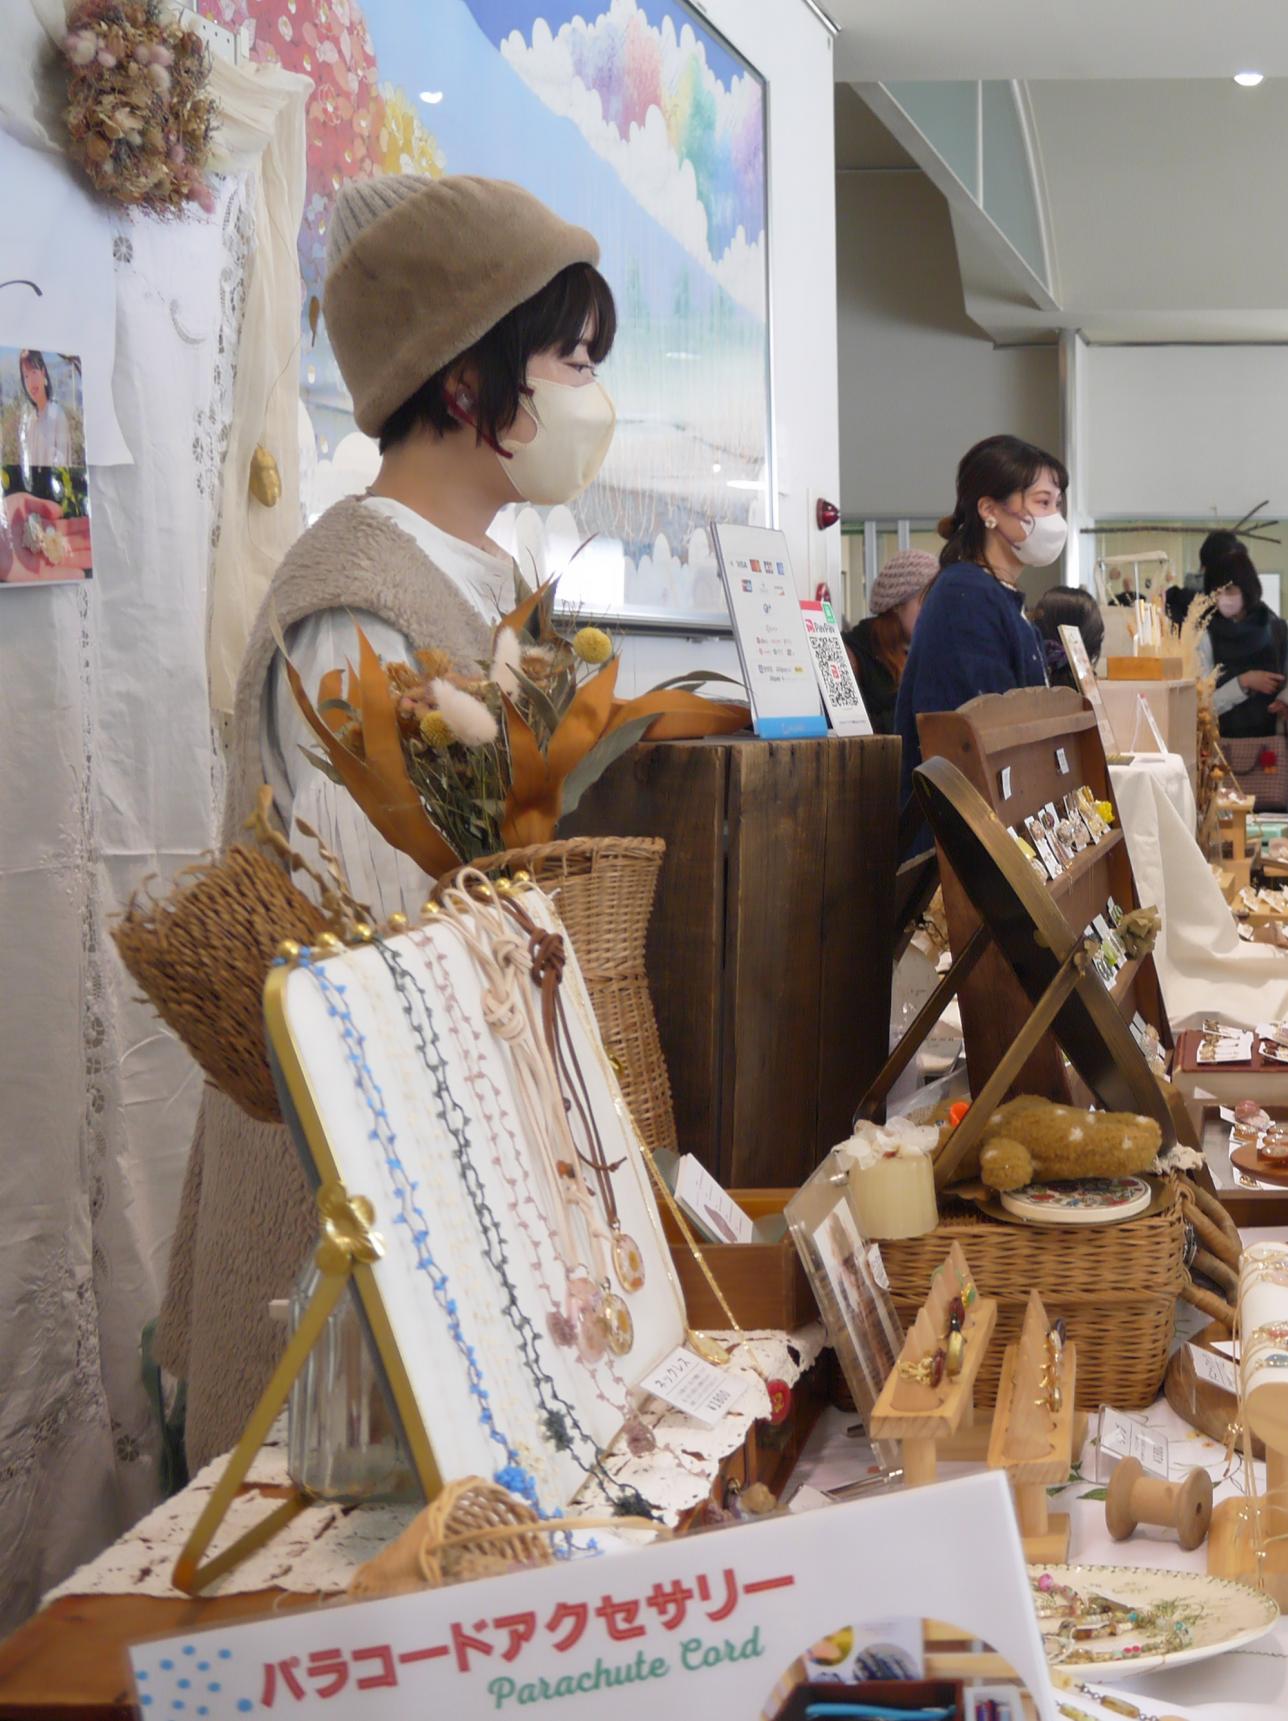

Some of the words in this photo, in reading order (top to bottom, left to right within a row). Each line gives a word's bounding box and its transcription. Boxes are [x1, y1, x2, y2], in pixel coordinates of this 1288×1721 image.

[261, 1568, 795, 1708] パラコードアクセサリー
[487, 1650, 672, 1710] Parachute
[680, 1625, 765, 1671] Cord
